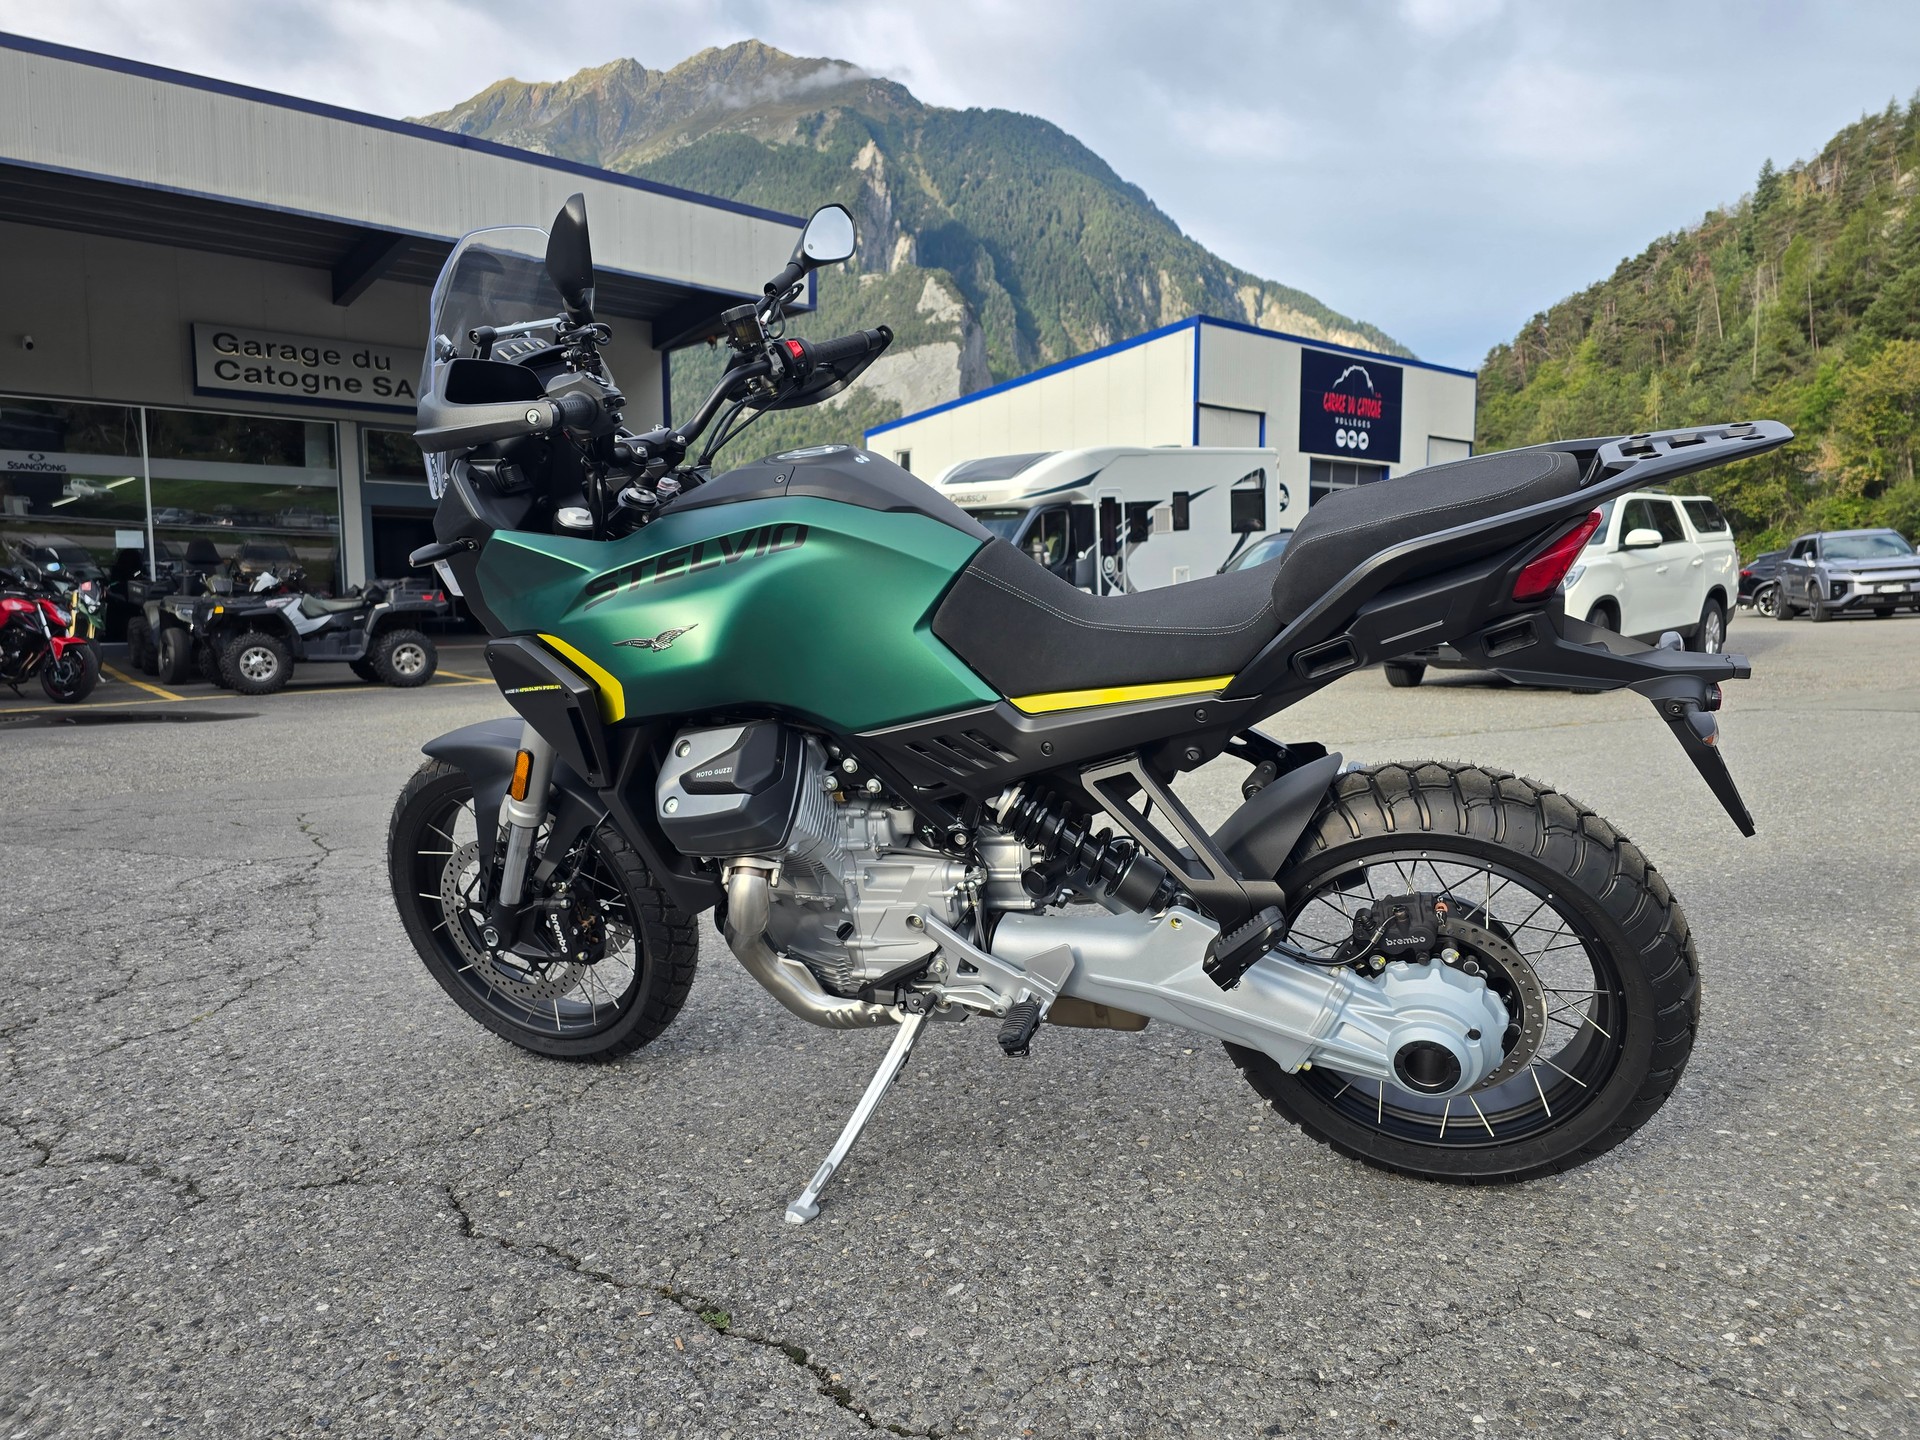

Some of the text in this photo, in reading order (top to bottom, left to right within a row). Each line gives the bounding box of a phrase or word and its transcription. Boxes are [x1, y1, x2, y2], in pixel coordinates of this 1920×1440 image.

[212, 332, 391, 371] Garage du
[214, 360, 415, 399] Catogne SA
[584, 523, 809, 612] STELVIO
[695, 766, 733, 778] MOTO GUZZI
[550, 913, 569, 953] brembo
[1385, 935, 1426, 946] brembo
